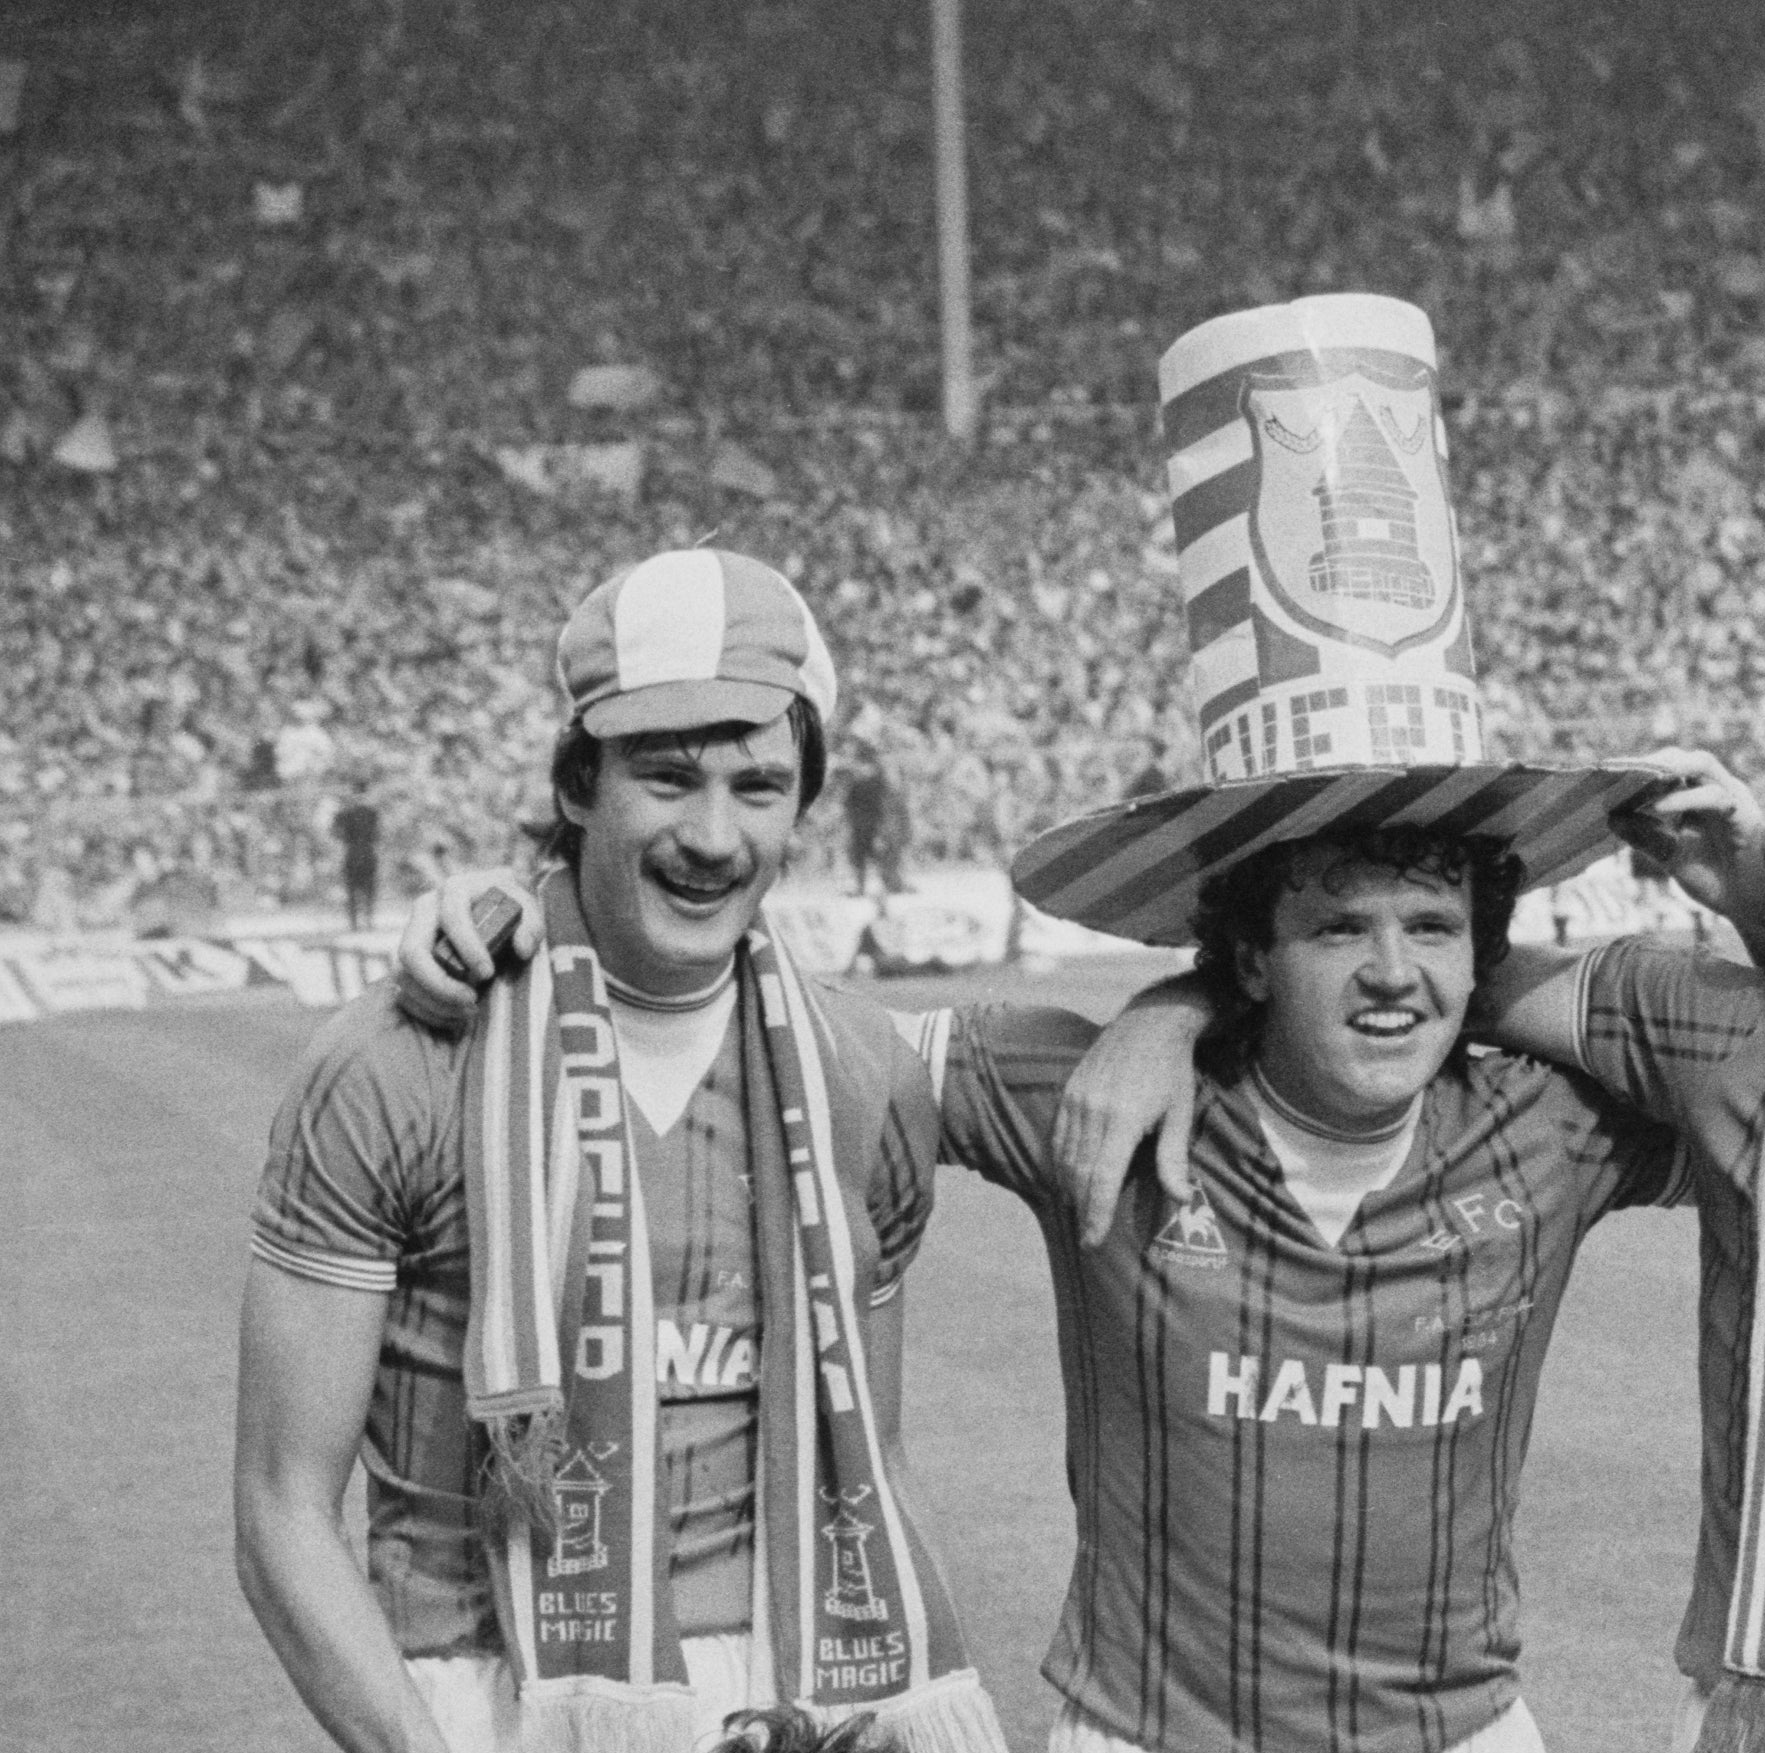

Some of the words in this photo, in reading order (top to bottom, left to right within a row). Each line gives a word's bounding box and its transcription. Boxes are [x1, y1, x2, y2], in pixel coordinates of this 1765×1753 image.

[1208, 1350, 1484, 1430] HAFNIA
[539, 1592, 617, 1616] BLUES
[540, 1618, 617, 1643] MAGIC
[818, 1631, 905, 1662] BLUES
[815, 1660, 908, 1690] MAGIC
